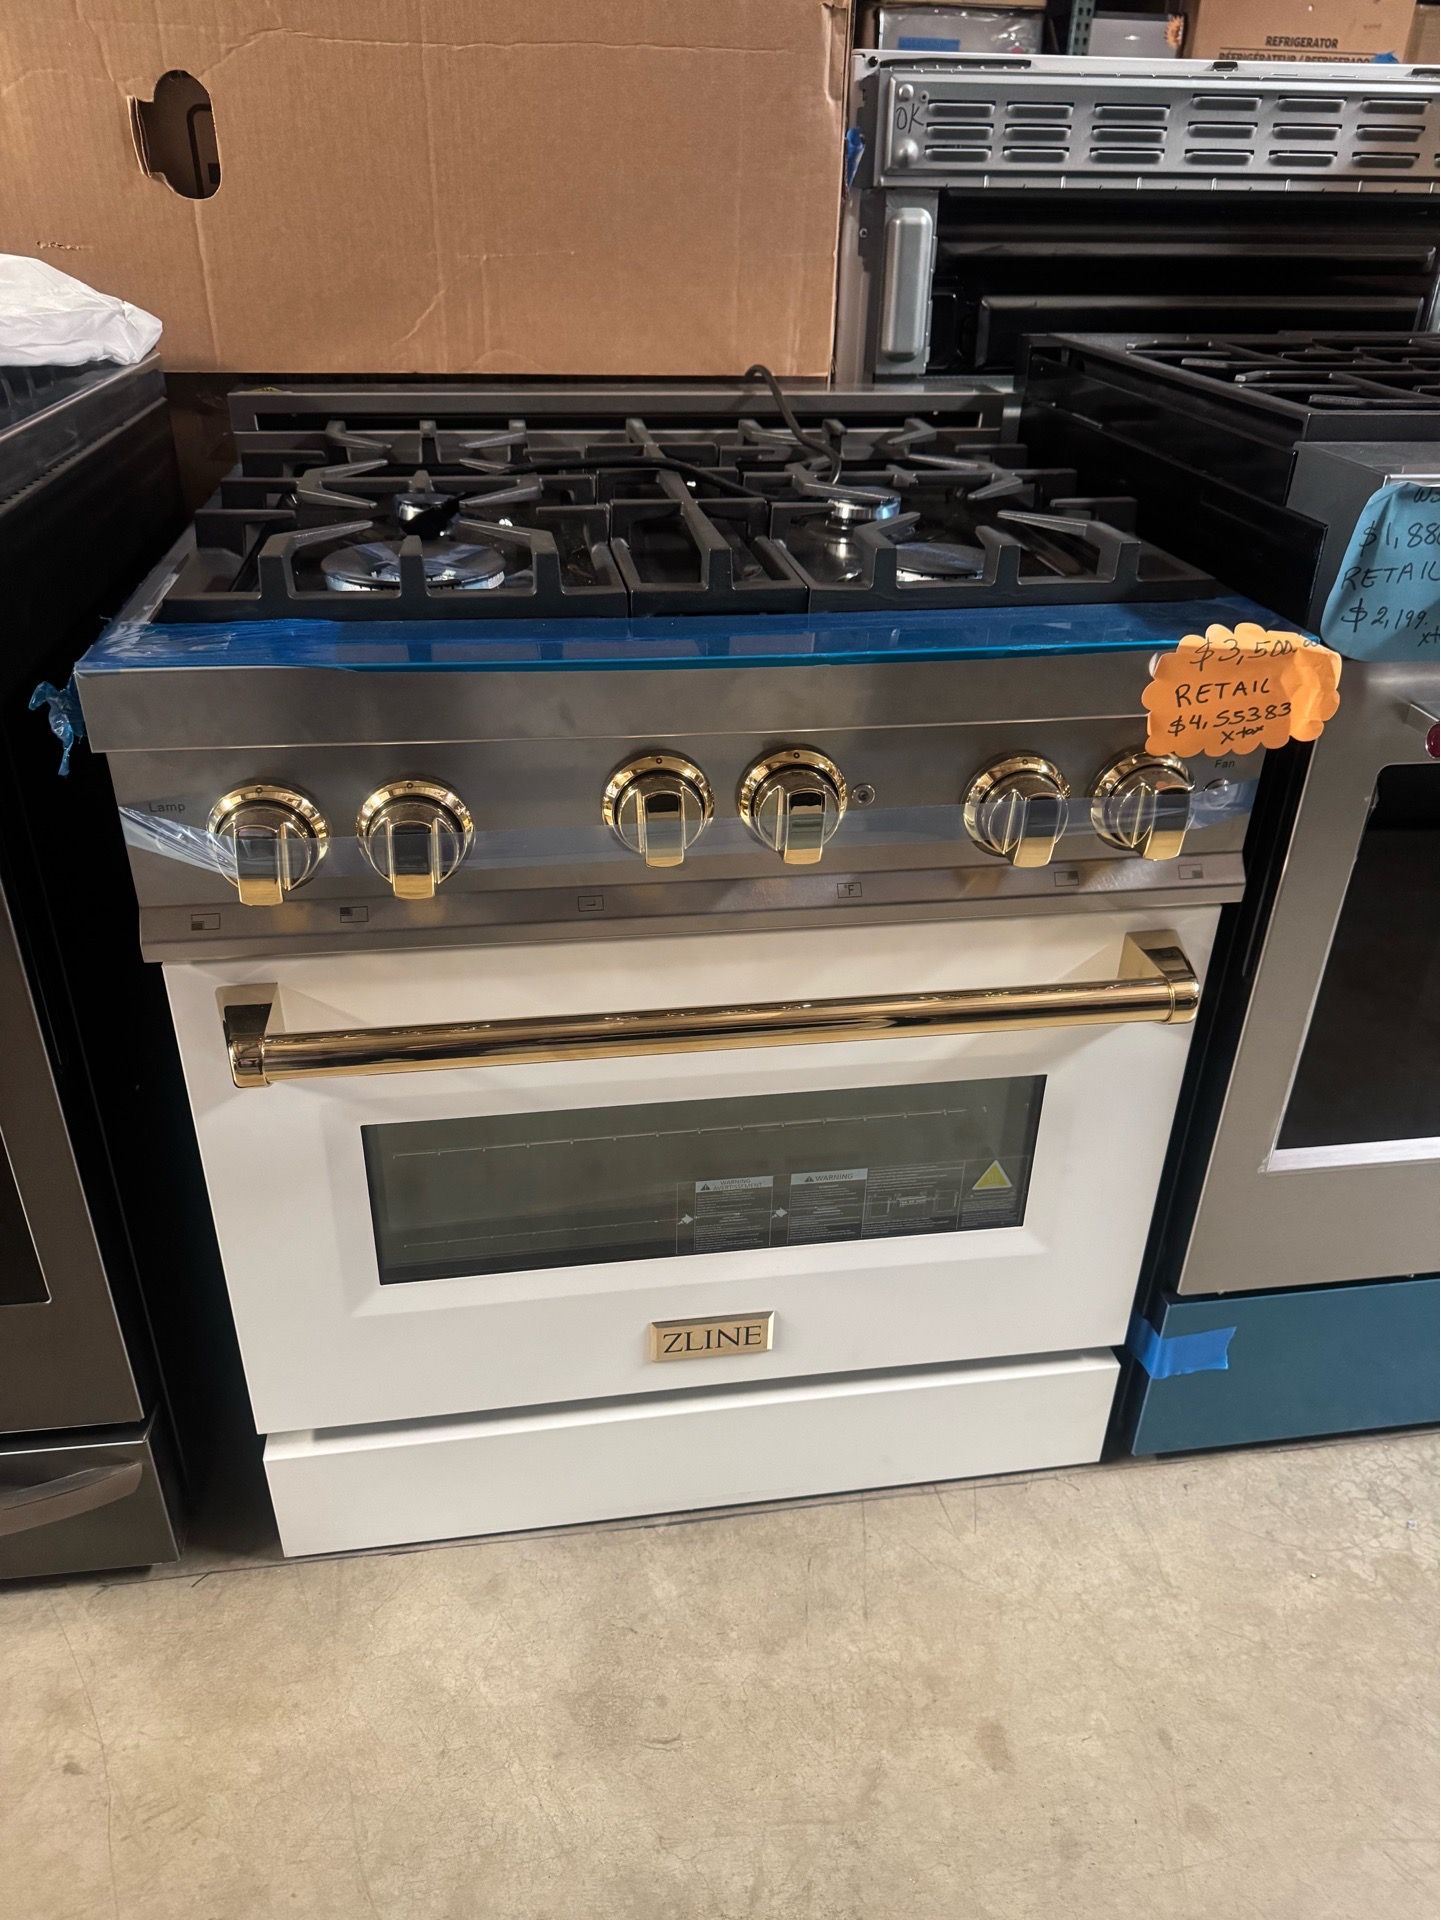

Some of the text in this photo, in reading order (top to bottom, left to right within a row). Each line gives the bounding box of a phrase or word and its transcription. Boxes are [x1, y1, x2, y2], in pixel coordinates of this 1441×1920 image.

[1265, 35, 1338, 48] REFRIGERATOR
[896, 103, 924, 134] OK
[1359, 520, 1440, 557] $1,88
[1341, 561, 1440, 590] RETAIL
[1175, 678, 1270, 707] RETAIL
[1214, 759, 1235, 769] Fan
[148, 802, 185, 813] Lamp
[815, 1173, 854, 1181] WARNING
[663, 1325, 761, 1353] ZLINE
